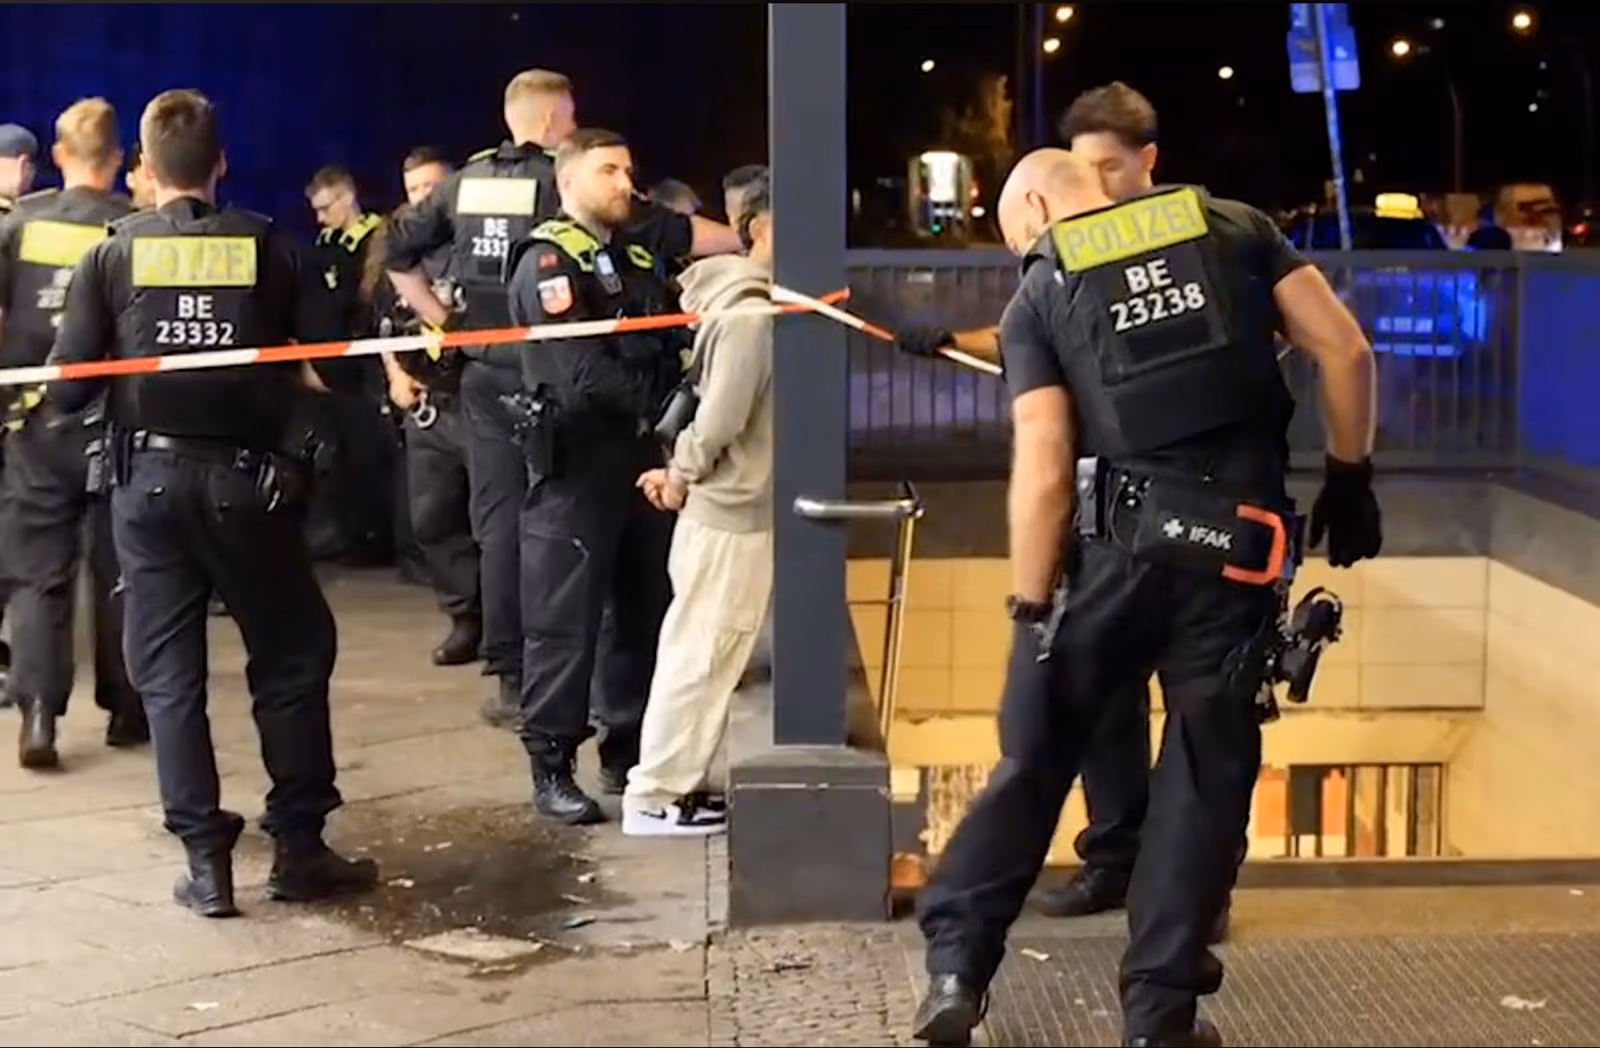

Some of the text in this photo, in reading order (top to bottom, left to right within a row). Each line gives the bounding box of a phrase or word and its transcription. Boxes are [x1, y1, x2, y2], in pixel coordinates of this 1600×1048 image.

[1064, 198, 1198, 260] POLIZEI
[1124, 259, 1172, 294] BE
[178, 294, 213, 319] BE
[1109, 282, 1206, 331] 23238
[156, 320, 234, 345] 23332
[1188, 526, 1232, 550] IFAK
